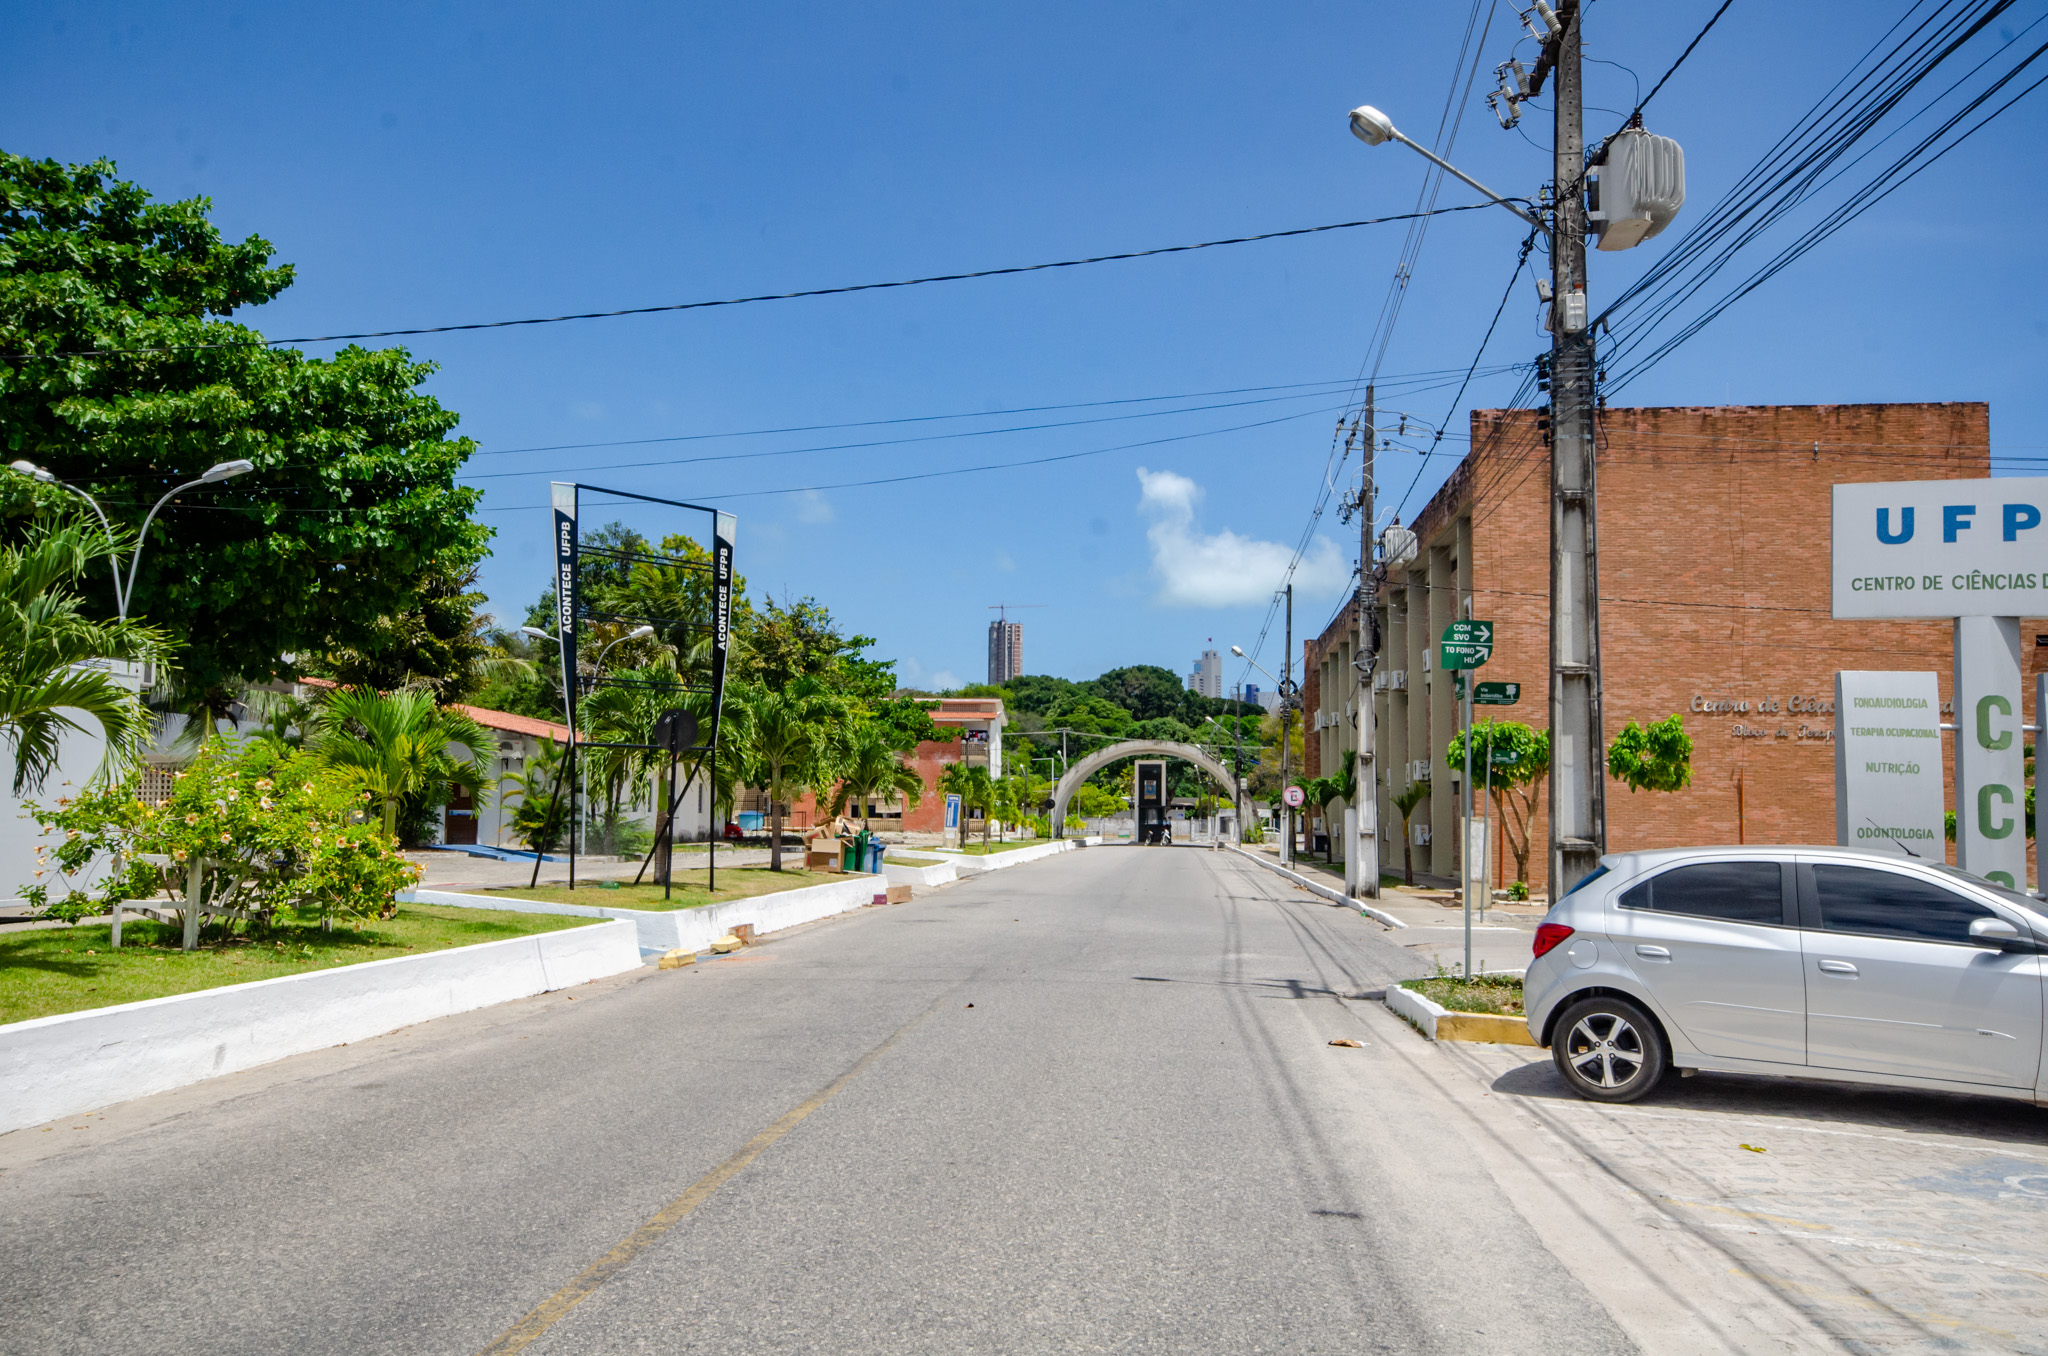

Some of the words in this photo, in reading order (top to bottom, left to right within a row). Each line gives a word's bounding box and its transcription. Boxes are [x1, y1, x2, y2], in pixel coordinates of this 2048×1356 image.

[561, 521, 571, 557] UFPB
[719, 547, 729, 580] UFPB
[1851, 575, 1916, 592] CENTRO
[1922, 574, 1943, 591] DE
[1952, 569, 2038, 591] CIÊNCIAS
[561, 563, 572, 634] ACONTECE
[717, 585, 729, 650] ACONTECE
[1453, 633, 1469, 641] SVO
[1456, 646, 1475, 654] FONO
[1464, 656, 1475, 664] HU
[1690, 694, 1749, 713] Centro
[1758, 696, 1781, 713] de
[1853, 696, 1929, 709] FONOAUDIOLOGIA
[1775, 725, 1790, 738] de
[1850, 727, 1885, 737] TERAPIA
[1885, 727, 1940, 739] OCUPACIONAL
[1856, 826, 1936, 841] ODONTOLOGIA
